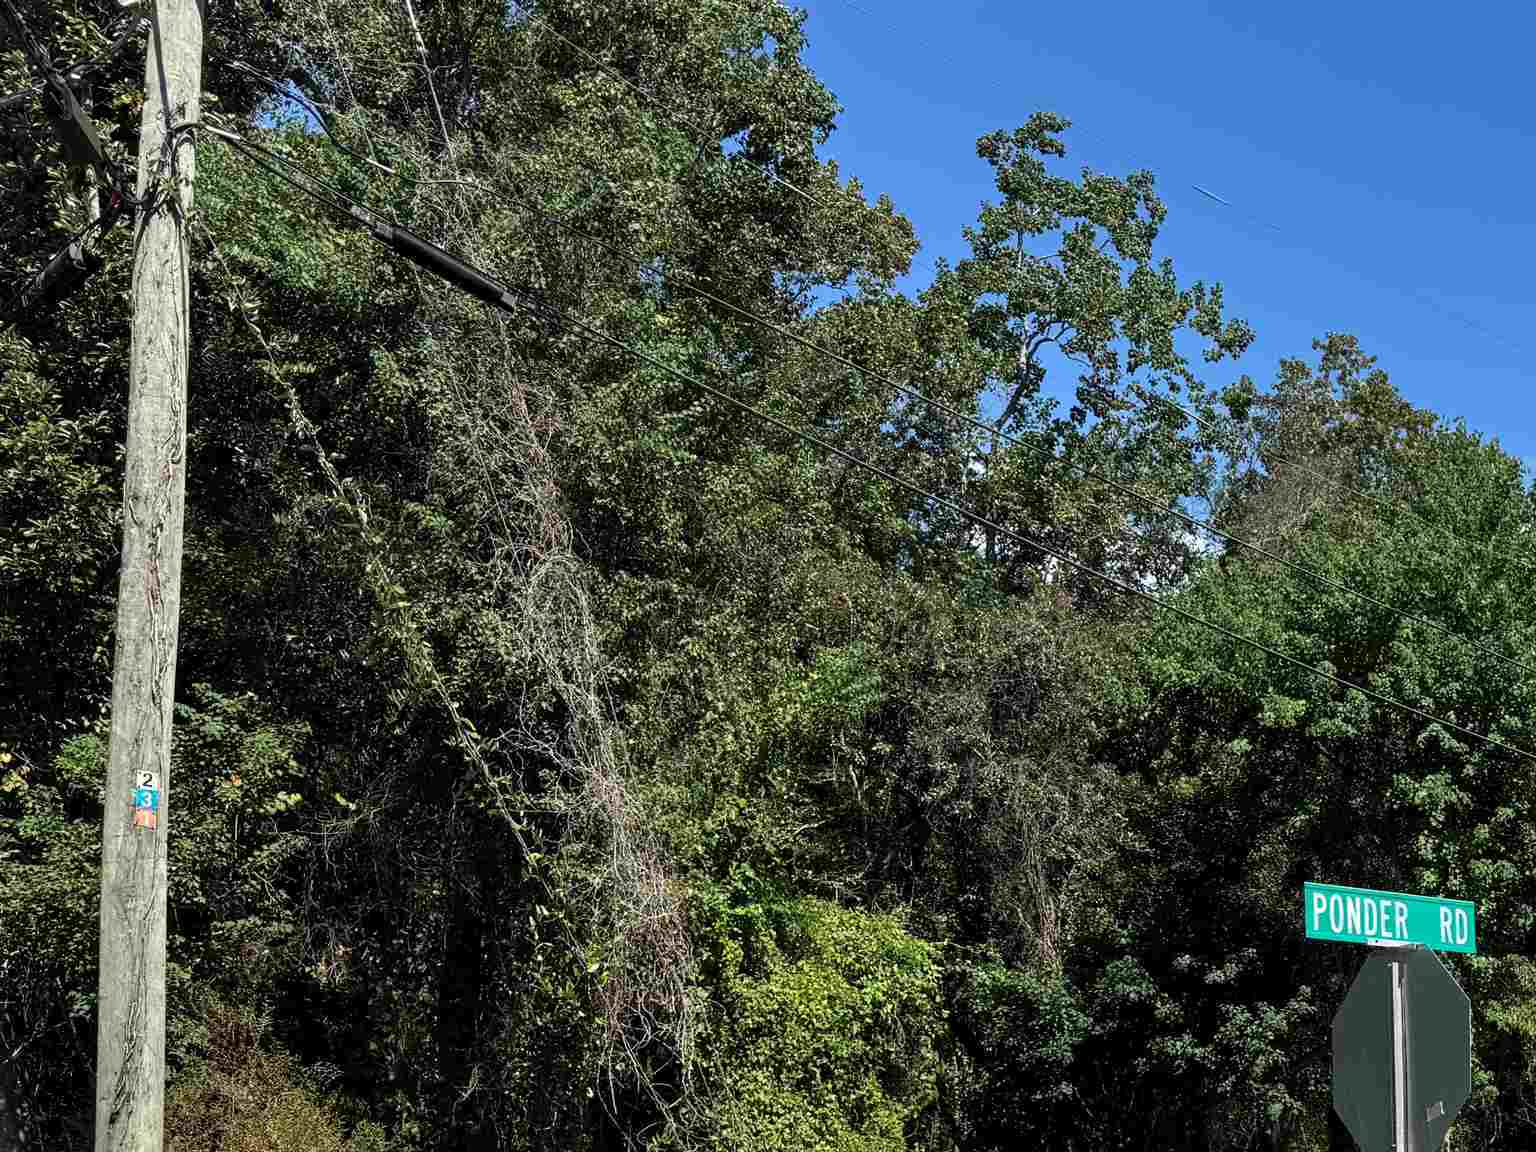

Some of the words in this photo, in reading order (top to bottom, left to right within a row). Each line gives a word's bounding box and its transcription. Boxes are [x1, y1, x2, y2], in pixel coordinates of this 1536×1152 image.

[142, 773, 153, 787] 2
[141, 792, 152, 808] 3
[1313, 893, 1408, 939] PONDER
[1440, 905, 1468, 944] RD
